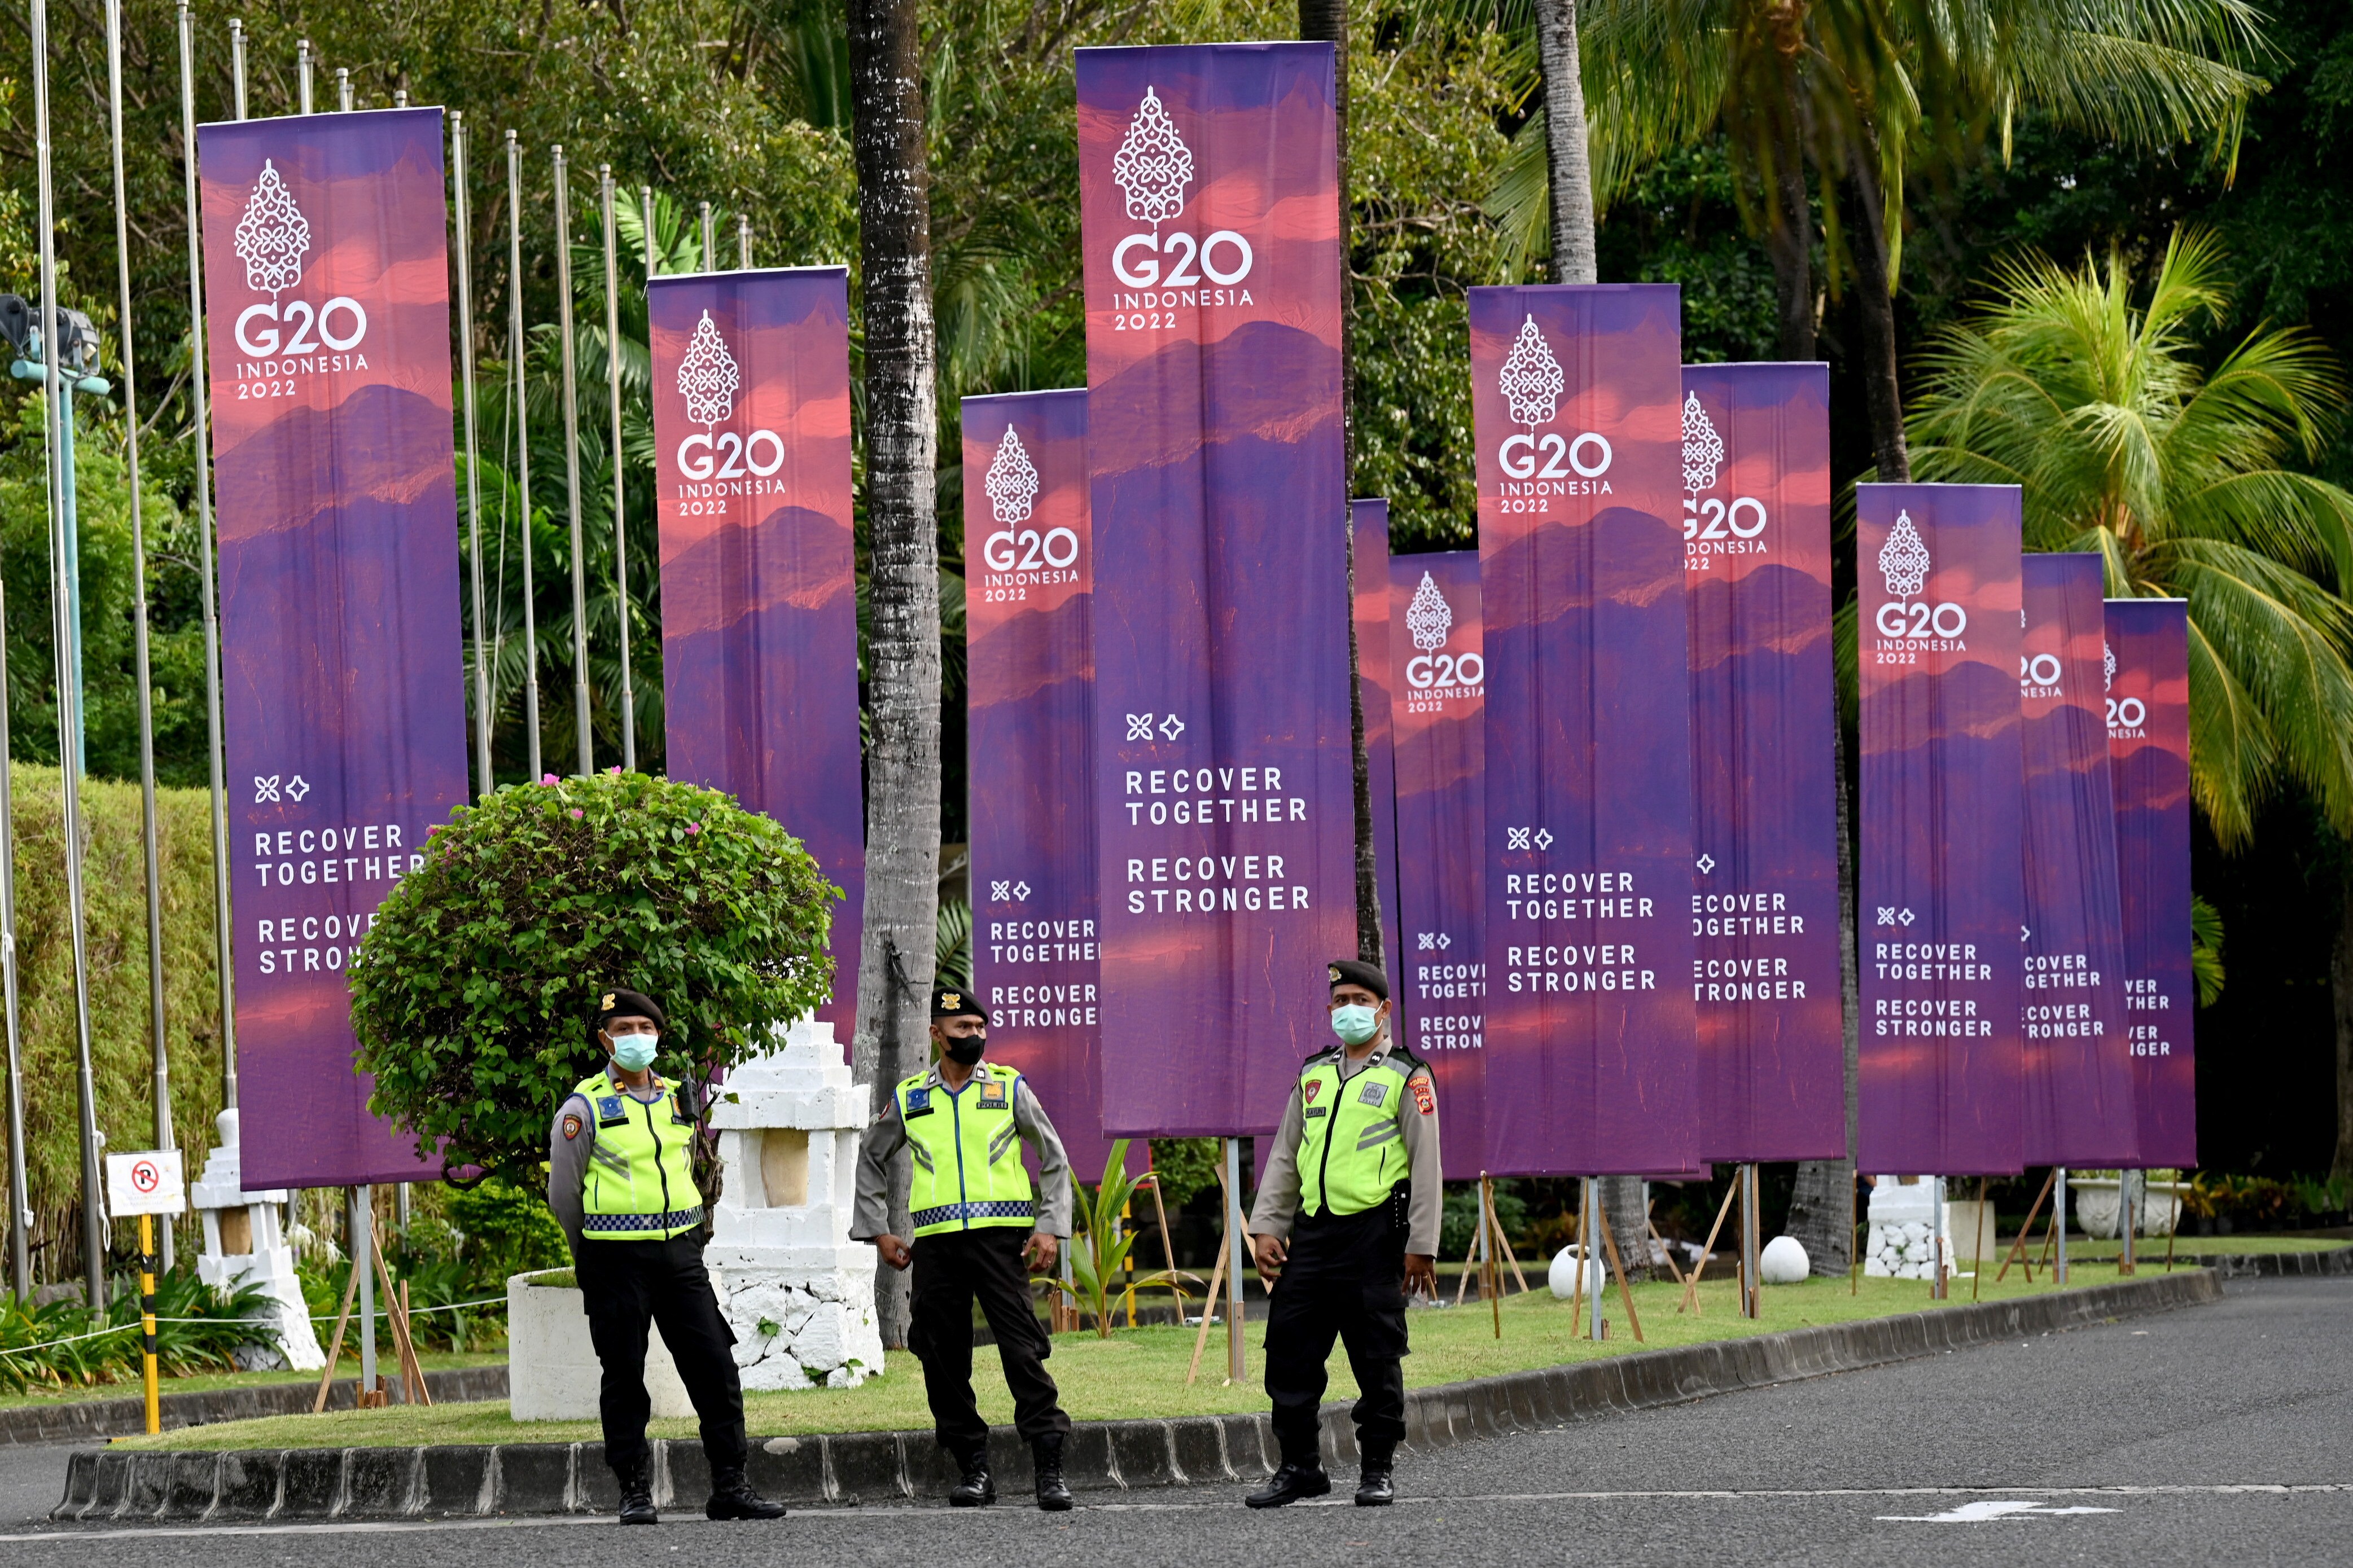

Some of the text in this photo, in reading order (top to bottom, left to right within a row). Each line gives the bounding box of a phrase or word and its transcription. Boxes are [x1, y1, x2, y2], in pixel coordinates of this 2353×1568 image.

[1112, 231, 1252, 288] G20
[1114, 290, 1253, 310] INDONESIA
[235, 297, 366, 357] G20
[1115, 313, 1175, 330] 2022
[237, 354, 368, 379] INDONESIA
[238, 380, 295, 399] 2022
[677, 430, 784, 480] G20
[1499, 433, 1611, 478] G20
[679, 480, 785, 498] INDONESIA
[1500, 481, 1612, 496] INDONESIA
[680, 500, 726, 516] 2022
[1501, 499, 1548, 513] 2022
[984, 528, 1077, 571] G20
[1685, 557, 1709, 570] 22
[985, 570, 1077, 587] INDONESIA
[985, 588, 1026, 602] 2022
[1877, 601, 1966, 638] G20
[1877, 640, 1965, 651] INDONESIA
[1877, 653, 1915, 664] 2022
[1406, 652, 1483, 688] G20
[1408, 687, 1484, 700] INDONESIA
[1409, 701, 1442, 713] 2022
[1127, 767, 1281, 794] RECOVER
[1126, 798, 1305, 825] TOGETHER
[256, 825, 401, 855] RECOVER
[1128, 855, 1284, 882] RECOVER
[1508, 873, 1633, 893] RECOVER
[1128, 886, 1308, 913] STRONGER
[1507, 898, 1653, 919] TOGETHER
[1692, 893, 1785, 913] ECOVER
[991, 920, 1094, 940] RECOVER
[991, 942, 1101, 963] TOGETHE
[1509, 945, 1635, 965] RECOVER
[1877, 944, 1975, 960] RECOVER
[1509, 970, 1654, 991] STRONGER
[1876, 964, 1991, 980] TOGETHER
[992, 985, 1096, 1004] RECOVER
[1419, 982, 1486, 999] TOGET
[993, 1008, 1101, 1027] STRONGE
[1877, 1000, 1975, 1016] RECOVER
[2022, 1004, 2089, 1020] COVER
[1876, 1020, 1991, 1036] STRONGER
[2022, 1021, 2103, 1038] RONGER
[1421, 1034, 1482, 1049] STRON
